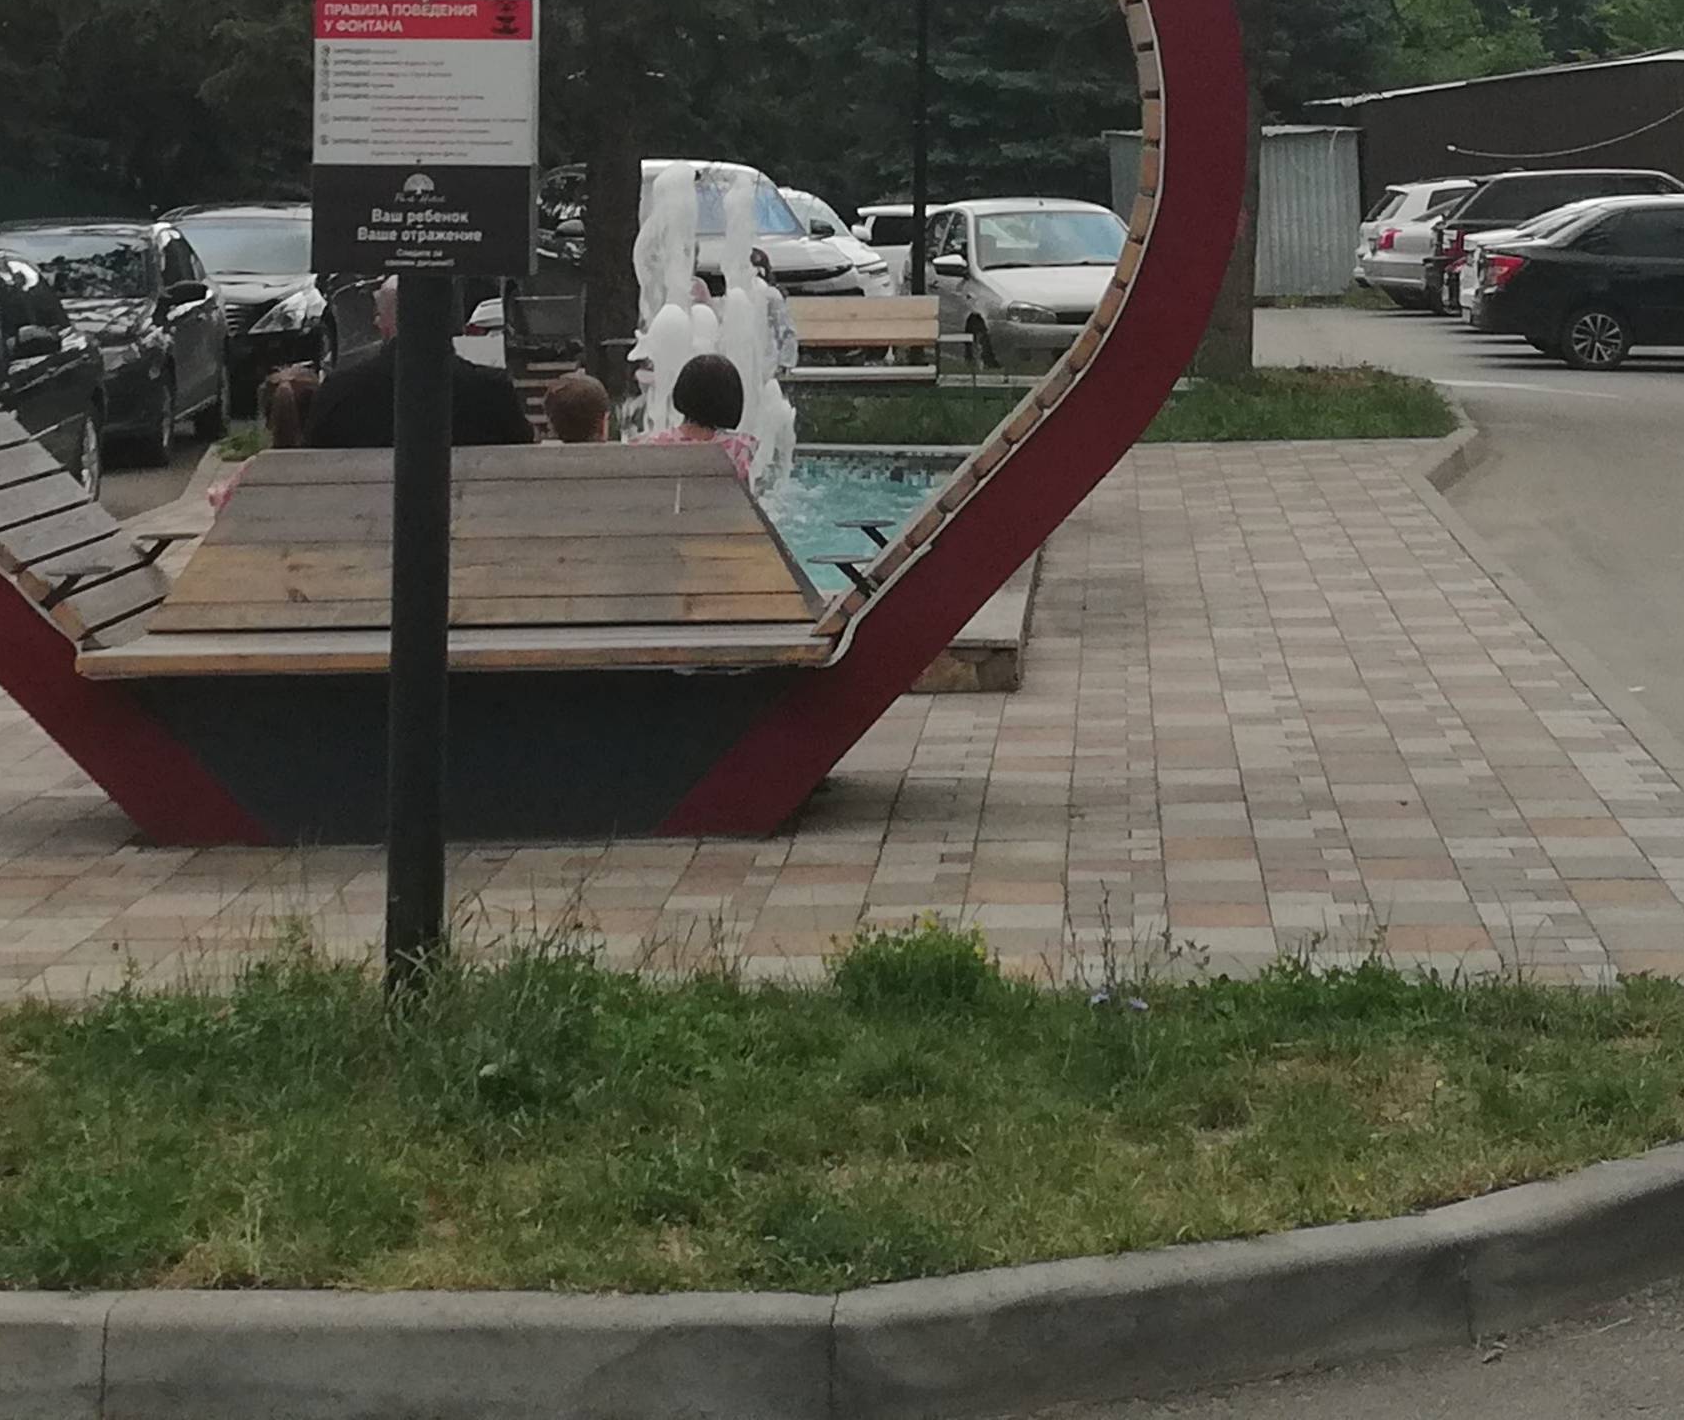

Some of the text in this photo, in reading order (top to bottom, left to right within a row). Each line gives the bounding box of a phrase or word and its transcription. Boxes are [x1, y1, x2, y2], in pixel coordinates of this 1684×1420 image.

[324, 3, 477, 18] ПРАВИЛА ПОВЕДЕНИЯ
[323, 20, 403, 33] У ФОНТАНА
[372, 208, 469, 225] Ваш ребенок
[358, 226, 483, 243] Ваше отражение
